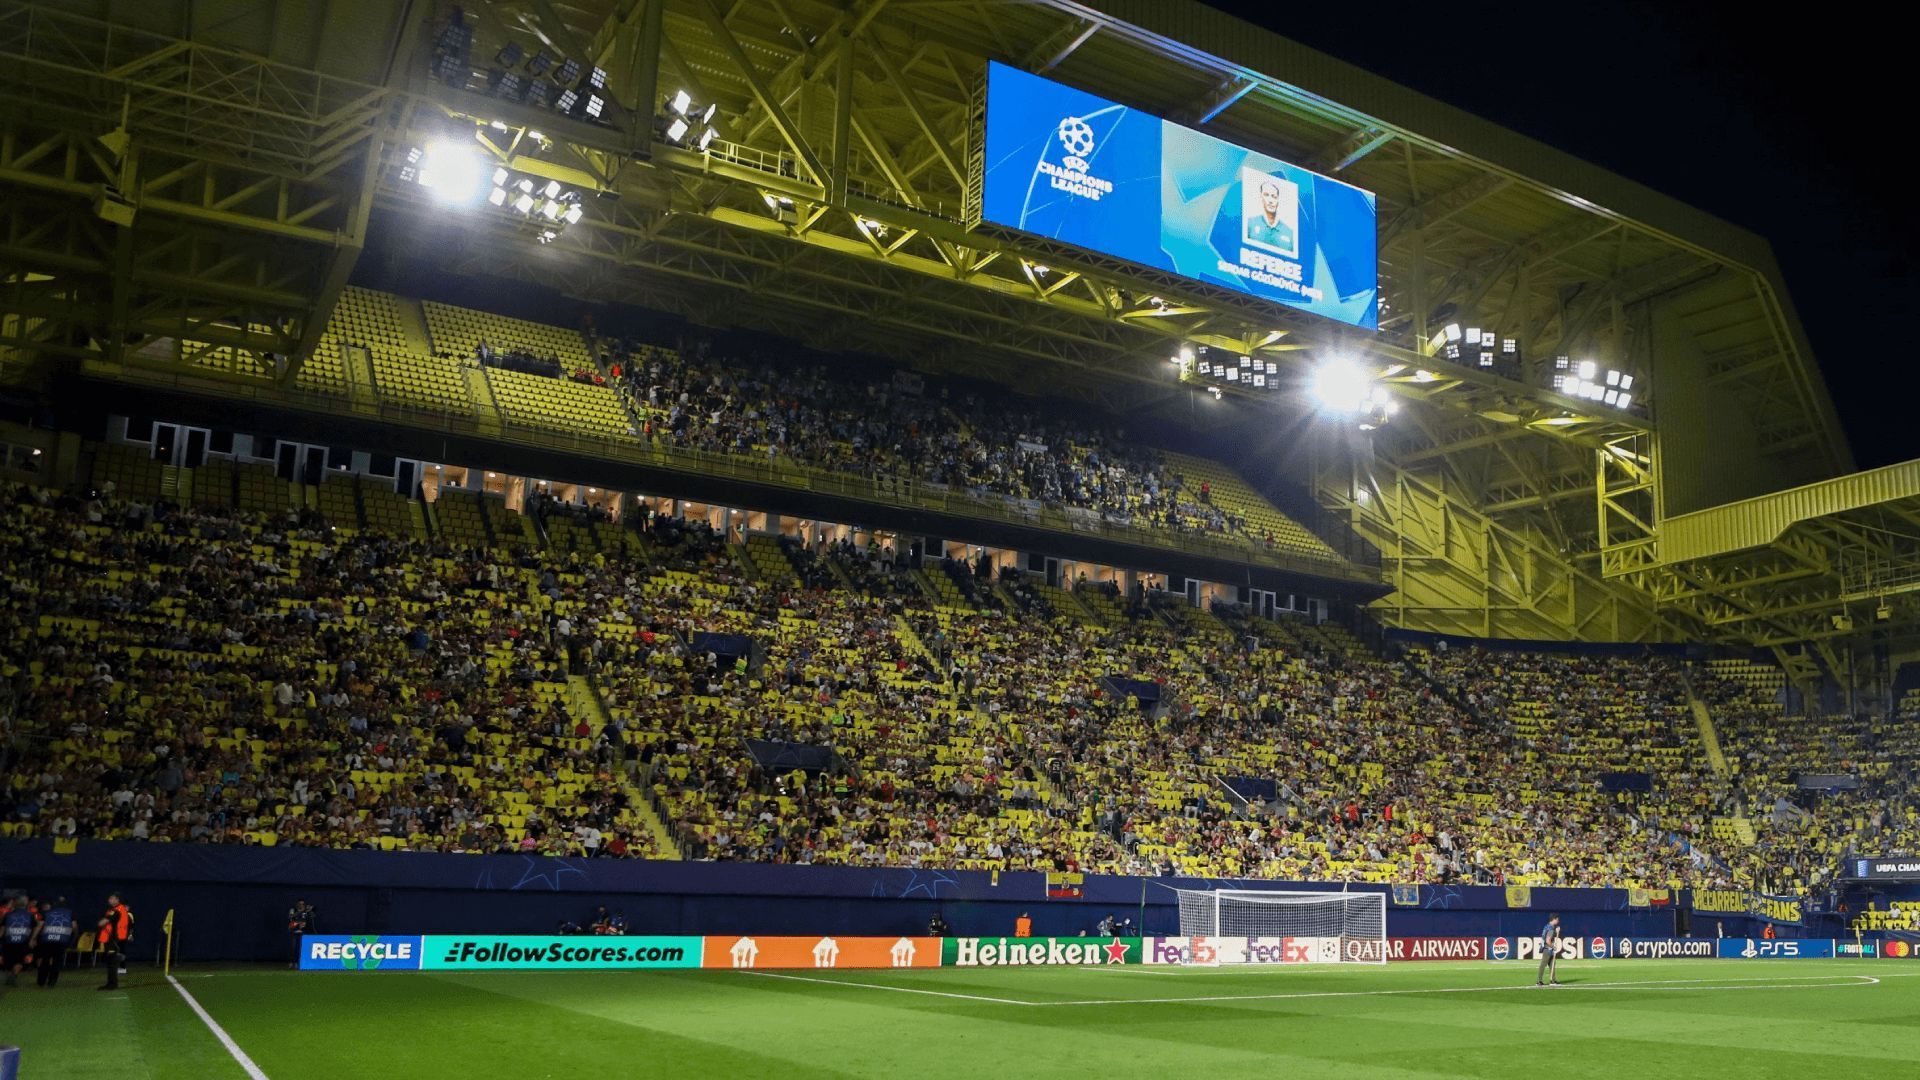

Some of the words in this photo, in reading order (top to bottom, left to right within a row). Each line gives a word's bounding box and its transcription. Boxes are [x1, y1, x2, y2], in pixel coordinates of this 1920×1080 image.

[1038, 160, 1112, 193] CHAMPIONS
[1240, 247, 1302, 283] REFEREE
[1876, 864, 1897, 872] UEFA
[1693, 889, 1745, 912] VILLARREAL
[1766, 900, 1801, 922] FANS
[311, 943, 412, 960] RECYCLE
[458, 942, 684, 963] FollowScores.com
[956, 937, 1101, 966] Heineken
[1153, 936, 1216, 963] FedEx
[1247, 936, 1309, 962] FedEx
[1411, 940, 1479, 958] AIRWAYS
[1635, 938, 1711, 958] crypto.com
[1760, 941, 1798, 955] PS5
